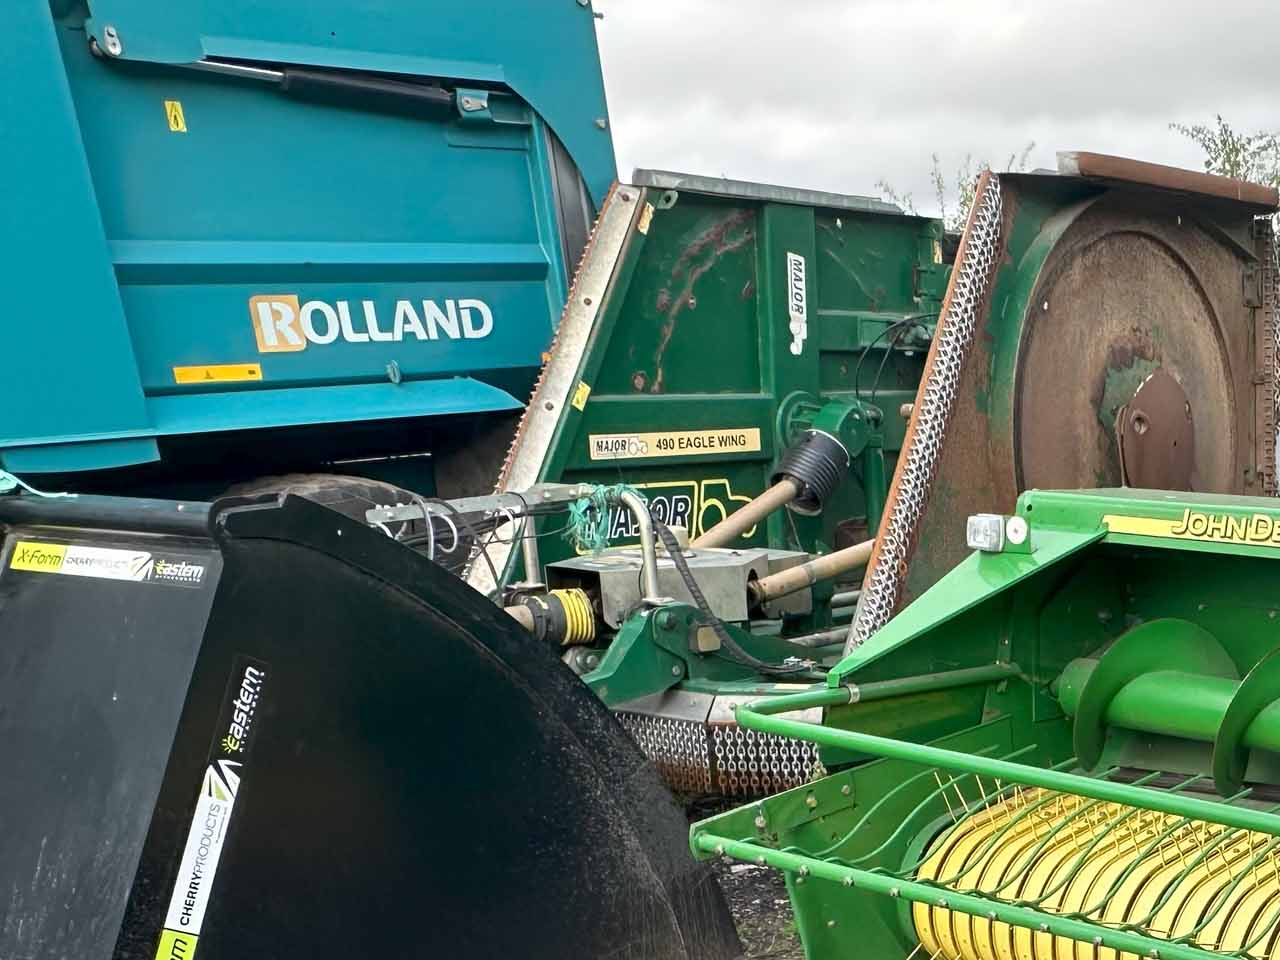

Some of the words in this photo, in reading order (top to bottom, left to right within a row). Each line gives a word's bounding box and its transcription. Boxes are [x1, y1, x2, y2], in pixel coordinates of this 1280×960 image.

[791, 258, 804, 316] MAJOR
[256, 299, 493, 346] ROLLAND
[596, 439, 627, 452] MAJOR
[656, 438, 675, 450] 490
[678, 436, 715, 449] EAGLE
[718, 434, 746, 447] WING
[17, 548, 61, 565] X-Form
[222, 666, 259, 753] eastern
